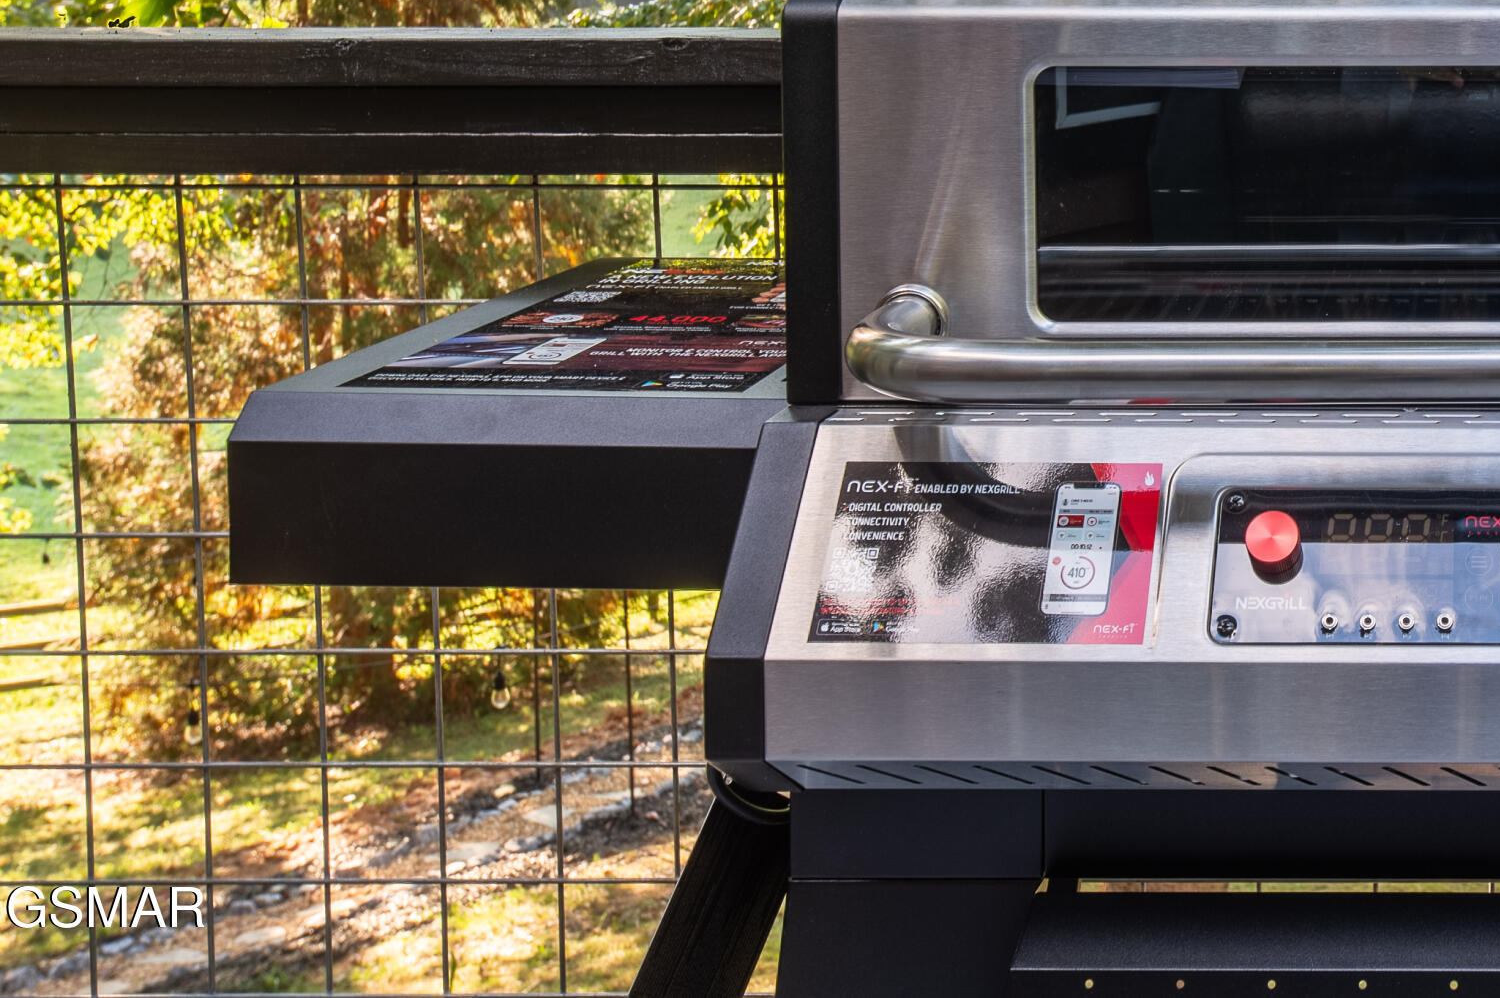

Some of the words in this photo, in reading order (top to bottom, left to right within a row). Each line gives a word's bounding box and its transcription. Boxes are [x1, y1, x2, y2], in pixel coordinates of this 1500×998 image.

[914, 484, 959, 494] ENABLED
[960, 484, 974, 494] BY
[974, 484, 1021, 495] NEXGRILL
[848, 502, 882, 512] DIGITAL
[884, 503, 942, 512] CONTROLLER
[1067, 567, 1086, 578] 410
